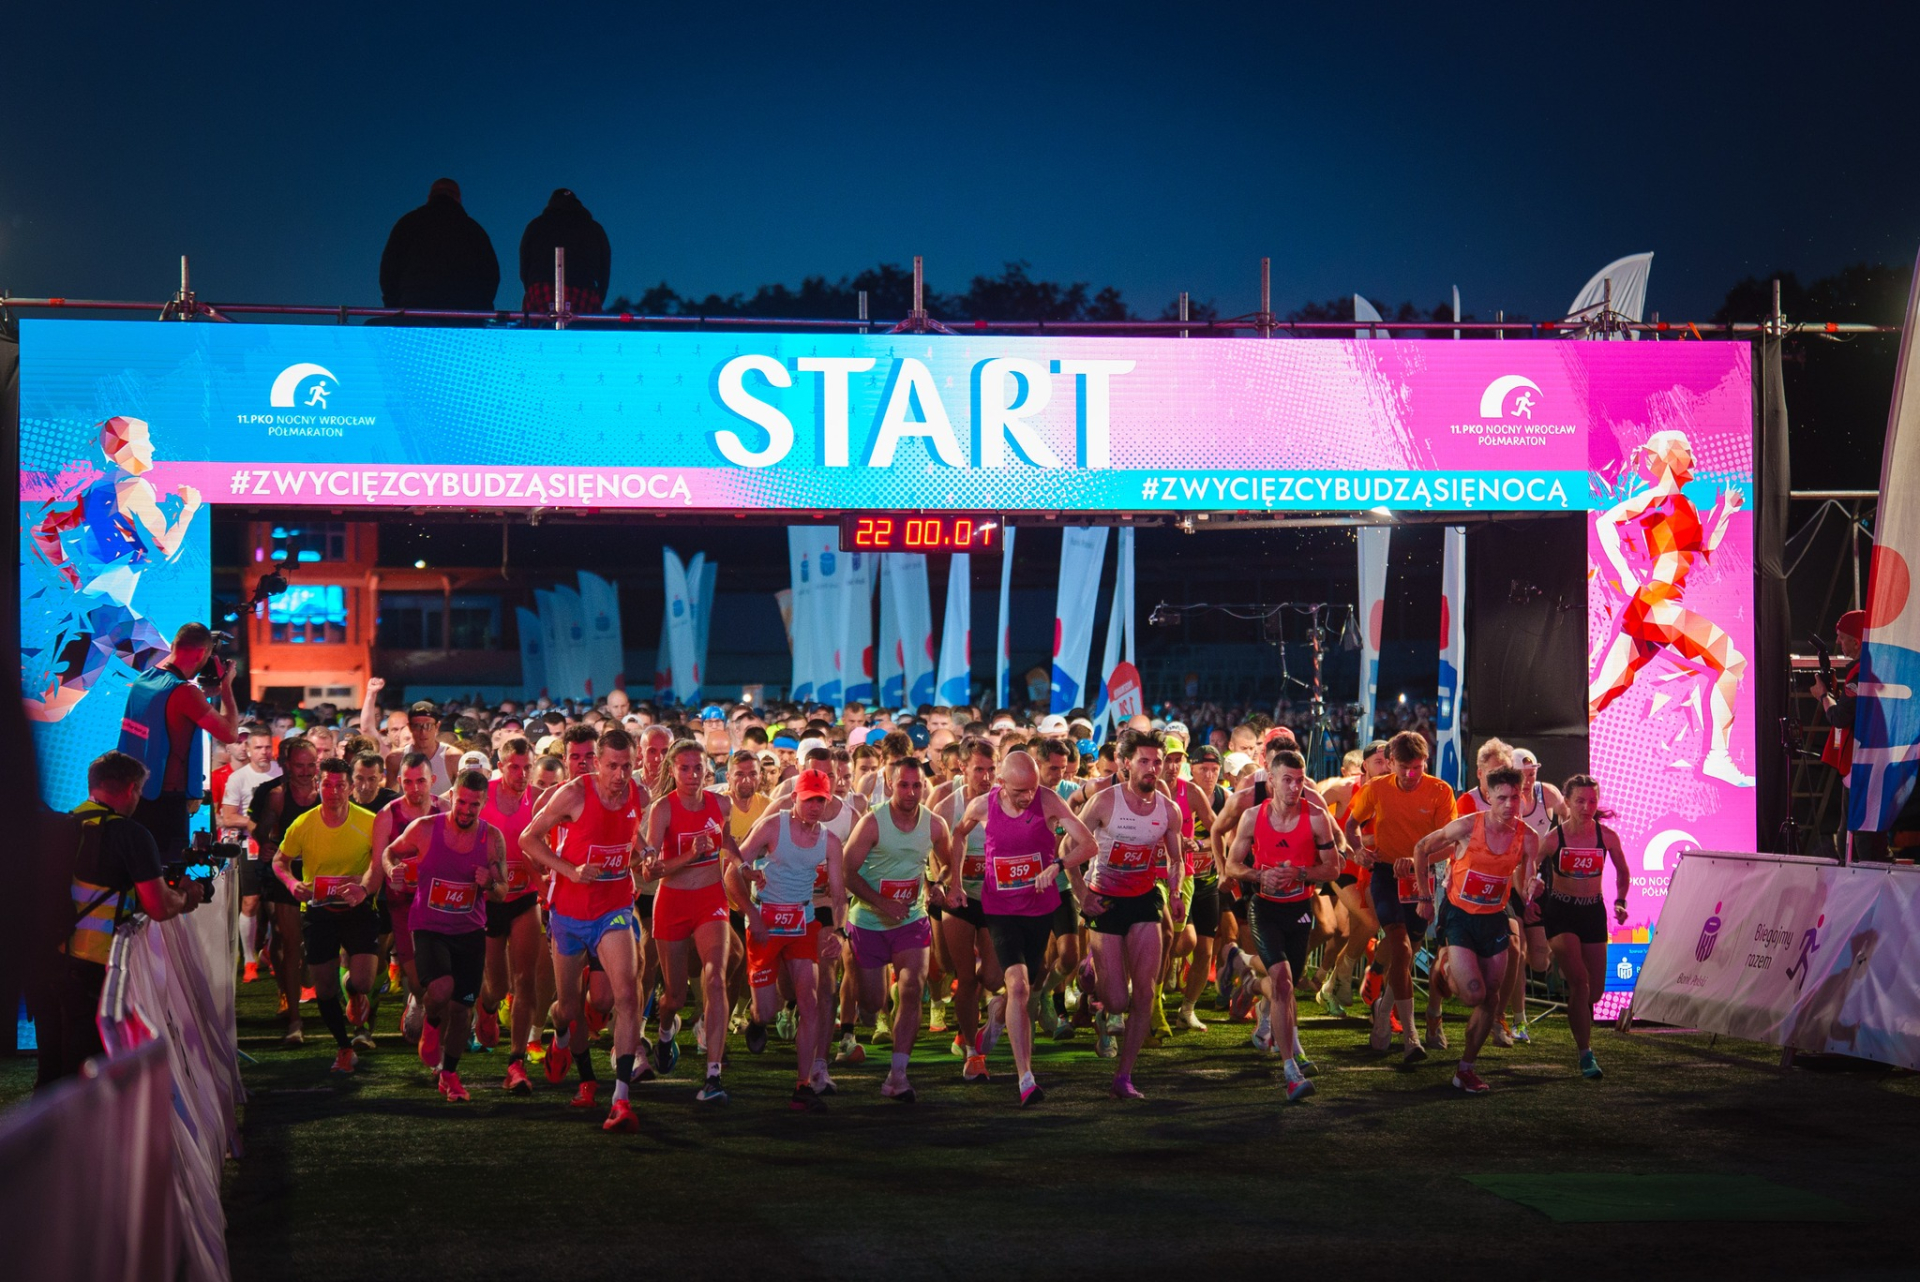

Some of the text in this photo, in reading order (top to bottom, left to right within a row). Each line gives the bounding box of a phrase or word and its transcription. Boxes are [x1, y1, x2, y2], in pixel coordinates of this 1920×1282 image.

[706, 354, 1137, 468] START
[276, 415, 316, 425] NOCNY
[319, 416, 376, 426] WROCŁAW
[268, 426, 343, 437] PÓŁMARATON
[1486, 425, 1522, 434] NOCNY
[1524, 425, 1576, 434] WROCŁAW
[1478, 435, 1546, 446] PÓŁMARATON
[230, 470, 692, 505] #ZWYCIĘZCYBUDZĄSIĘNOCĄ
[1141, 476, 1568, 507] #ZWYCIĘZCYBUDZĄSIĘNOCĄ
[855, 519, 893, 546] 22
[602, 854, 623, 868] 748
[1123, 851, 1143, 862] 954
[975, 862, 986, 872] 39
[1573, 857, 1593, 869] 243
[1009, 864, 1030, 878] 359
[1649, 876, 1671, 886] NOC
[326, 885, 337, 896] 18
[892, 888, 913, 900] 446
[1482, 883, 1494, 895] 31
[1642, 886, 1669, 897] PÓŁM
[445, 890, 464, 903] 146
[1551, 890, 1571, 903] PRO
[774, 911, 794, 924] 957
[1754, 923, 1794, 950] Biegajmy
[1747, 953, 1773, 970] razem
